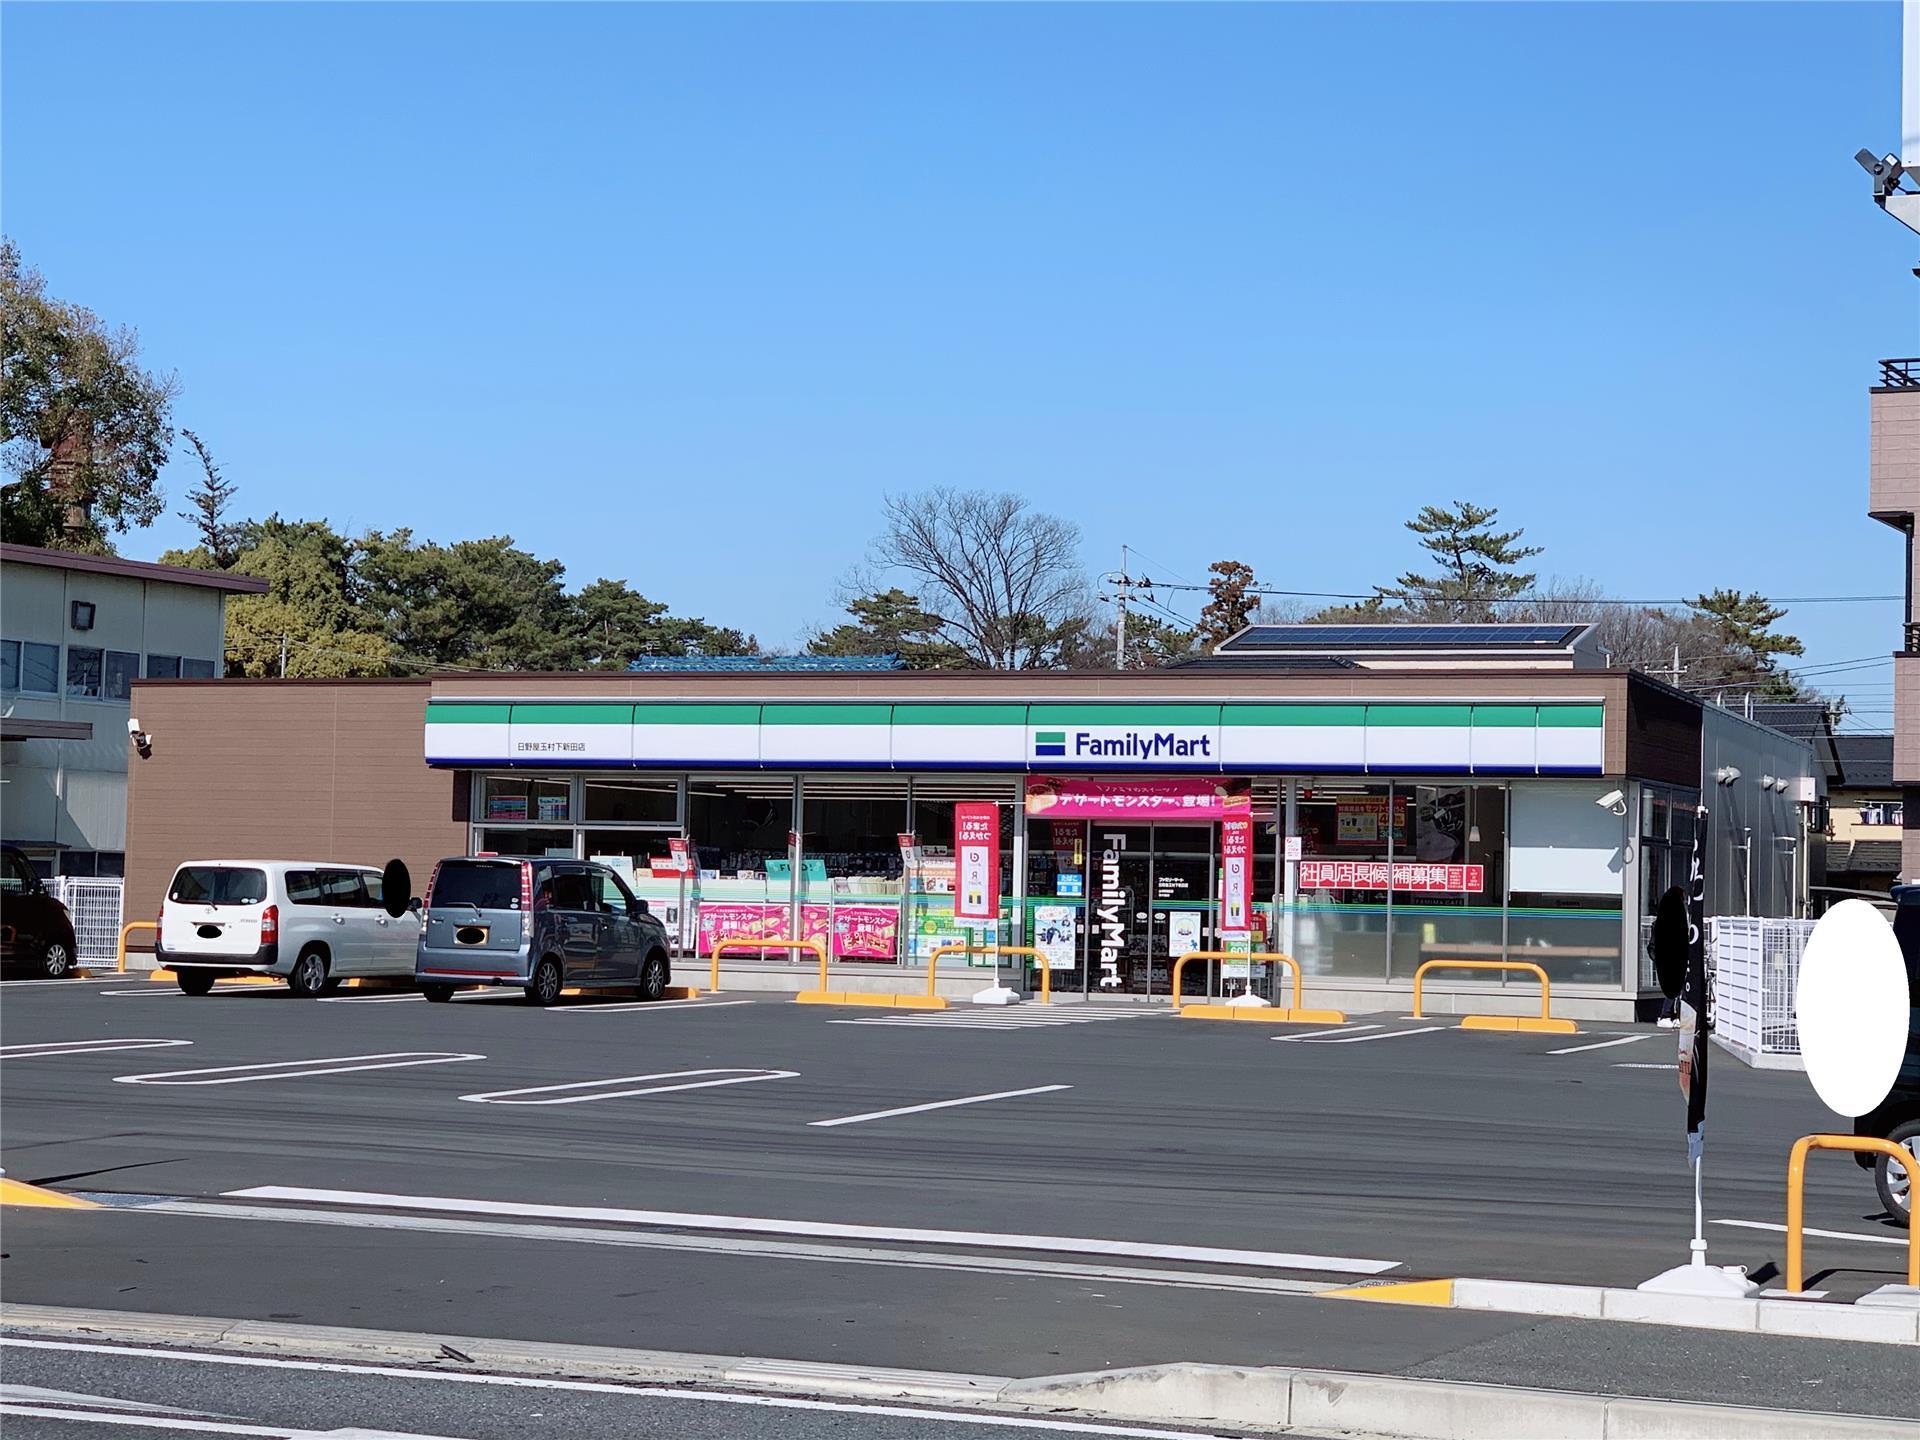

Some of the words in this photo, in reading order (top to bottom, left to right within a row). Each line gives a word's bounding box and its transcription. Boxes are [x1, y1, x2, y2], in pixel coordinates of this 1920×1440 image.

[517, 742, 586, 752] 日野屋玉村下新田店
[1076, 732, 1210, 759] FamilyMart
[1301, 864, 1446, 886] 社員店長候補募集
[1096, 833, 1127, 987] FamilyMart
